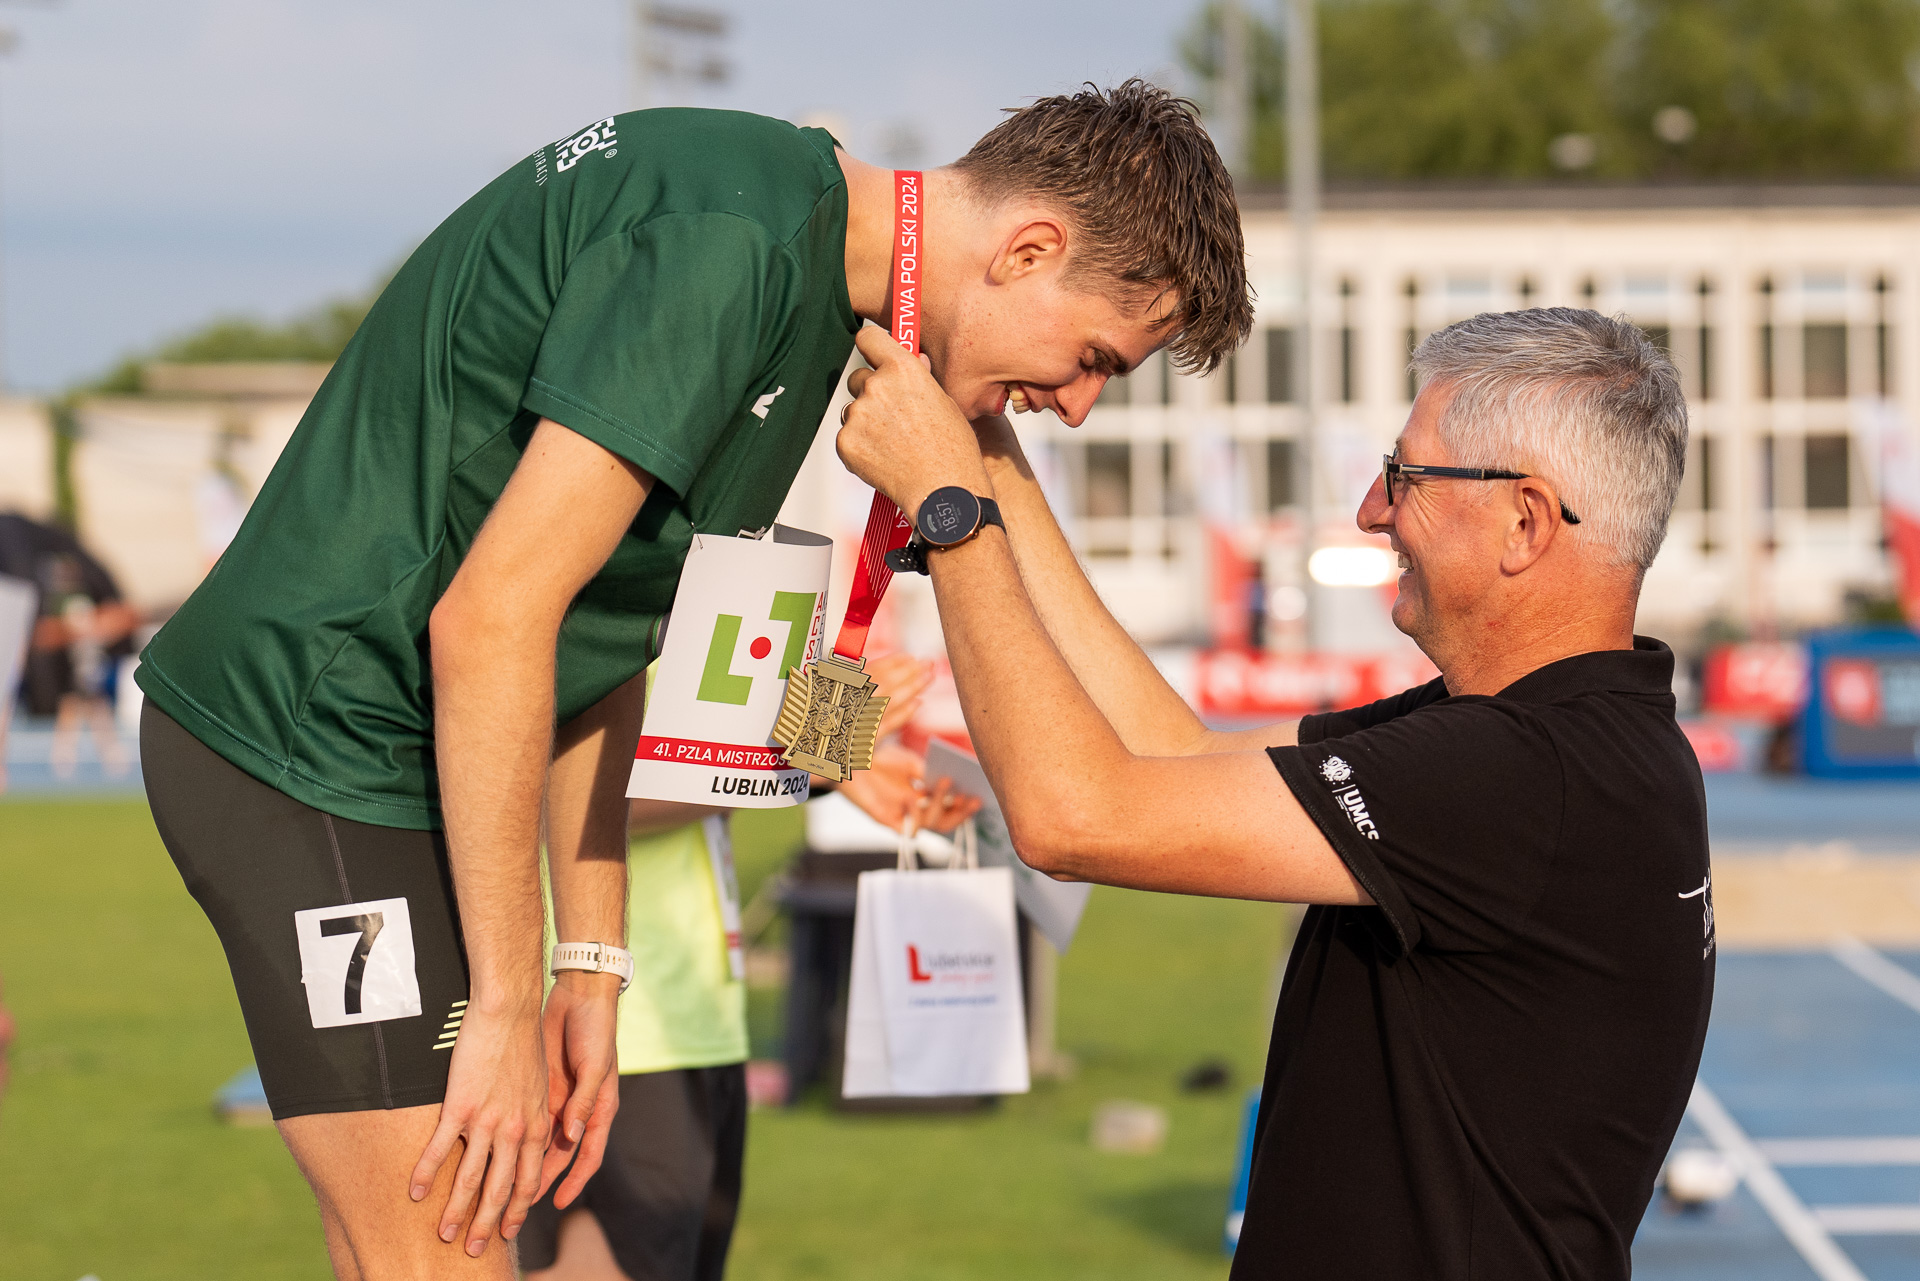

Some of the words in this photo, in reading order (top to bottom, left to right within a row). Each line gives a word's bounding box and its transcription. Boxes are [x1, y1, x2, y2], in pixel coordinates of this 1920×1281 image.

[902, 176, 917, 215] 2024
[901, 219, 917, 284] POLSKI
[653, 742, 672, 757] 41.
[676, 744, 712, 762] PZLA
[716, 749, 788, 766] MISTRZOS
[711, 776, 780, 796] LUBLIN
[781, 772, 809, 796] 2024
[319, 911, 384, 1016] 7
